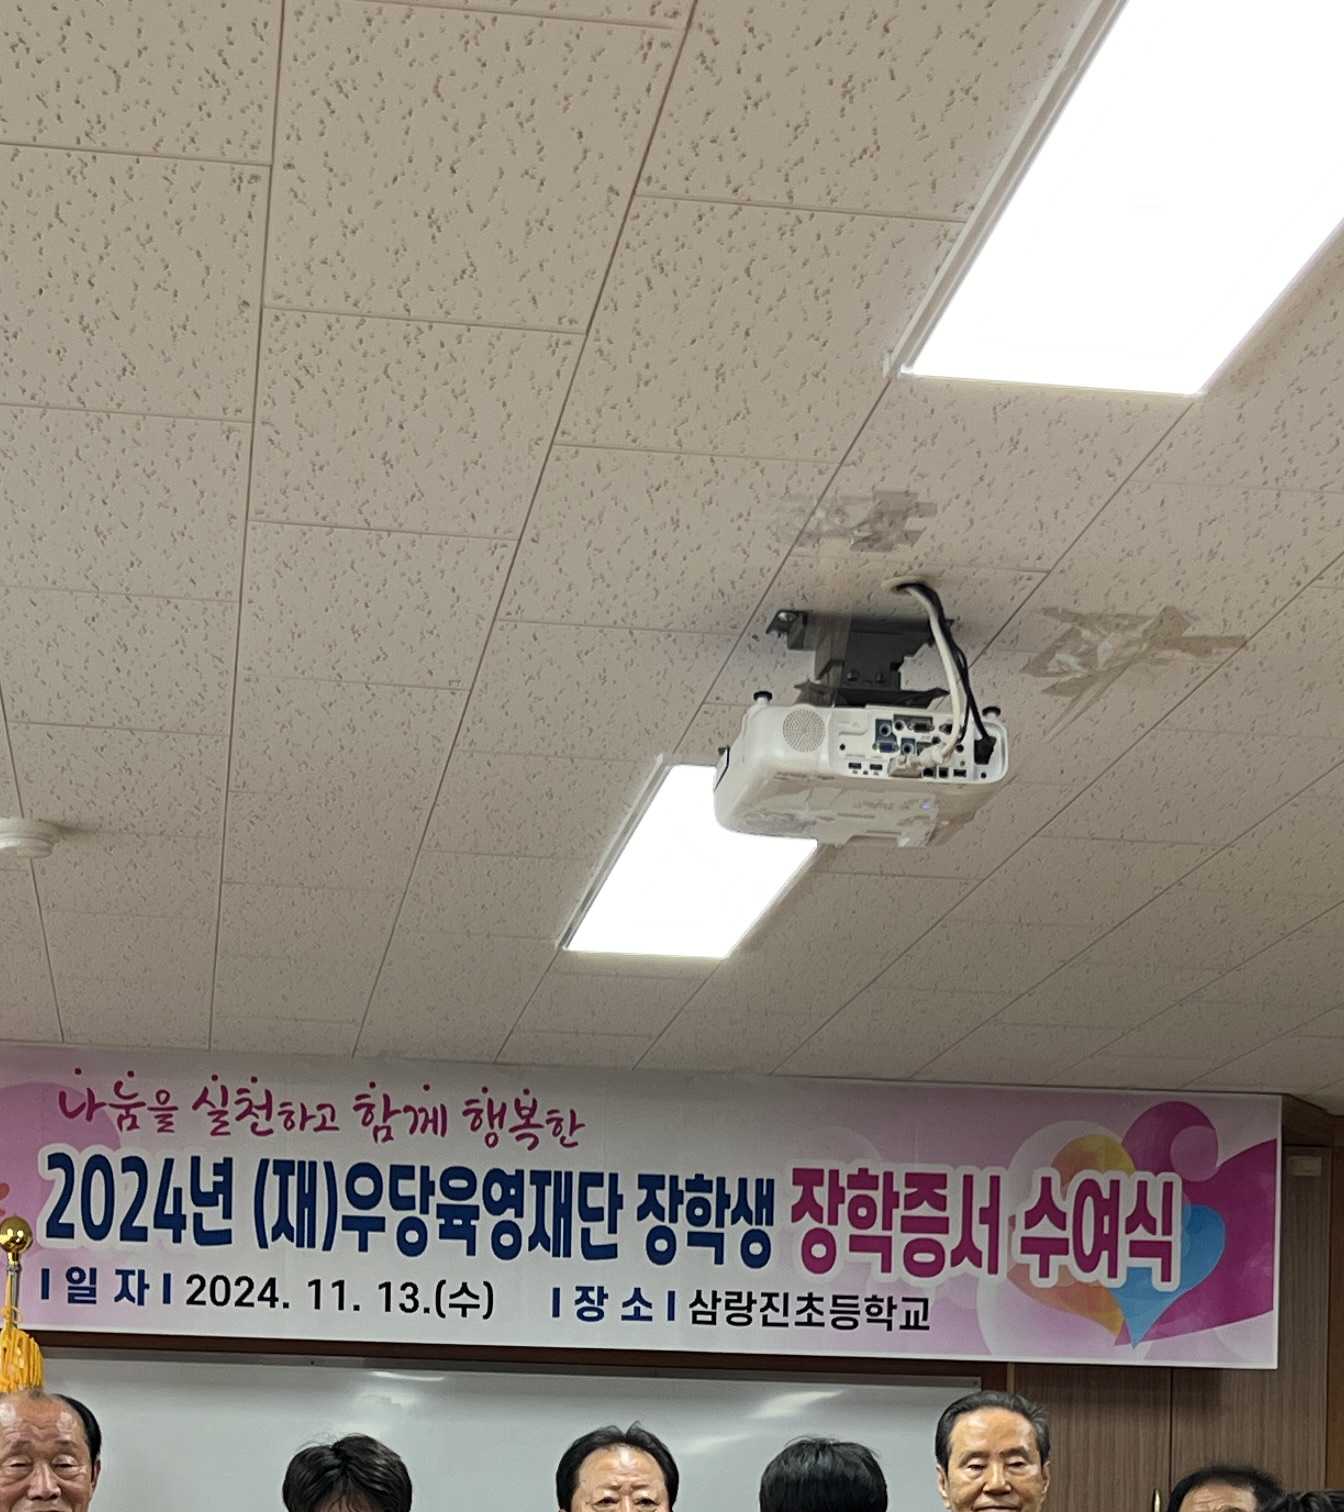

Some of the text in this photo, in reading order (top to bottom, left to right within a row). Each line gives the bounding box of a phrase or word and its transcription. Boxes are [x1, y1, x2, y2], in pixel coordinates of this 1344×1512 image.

[56, 1068, 585, 1150] 나눔을 실천하고 함께 행복한
[42, 1150, 1176, 1285] 2024년 (재)우당육영재단 장학생 장학증서 수여식
[186, 1274, 289, 1308] 2024.
[308, 1279, 360, 1311] 11.
[379, 1280, 493, 1319] 13.(수)
[689, 1290, 930, 1331] 삼랑진초등학교
